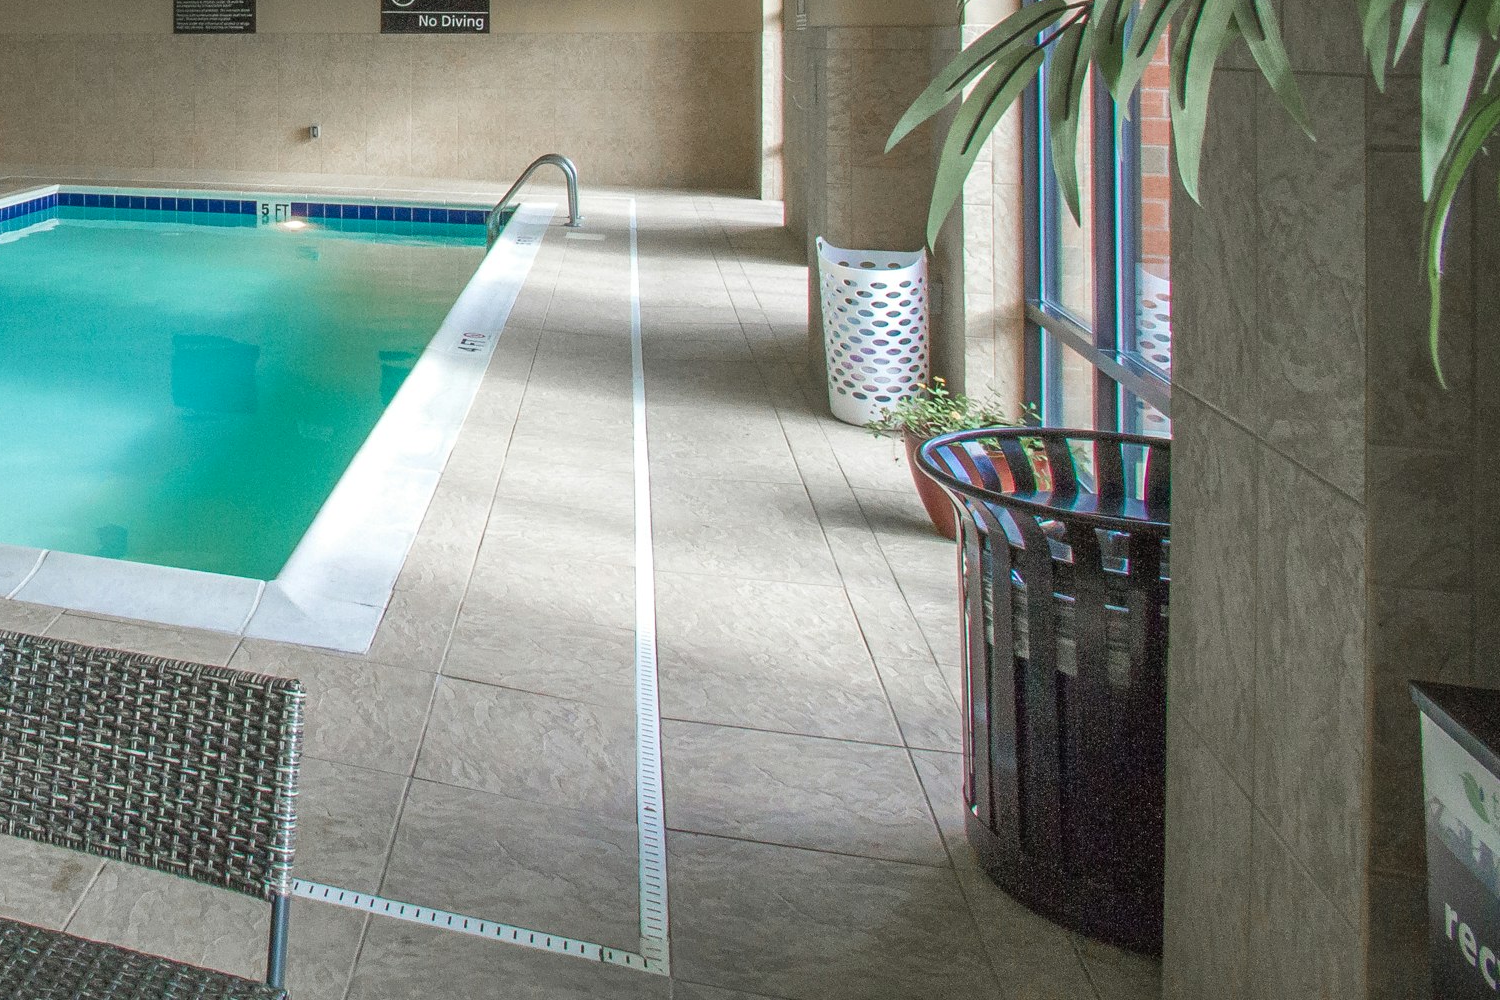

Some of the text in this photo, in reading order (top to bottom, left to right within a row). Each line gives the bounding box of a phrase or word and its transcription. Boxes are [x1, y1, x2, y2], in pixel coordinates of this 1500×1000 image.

[418, 14, 484, 30] No Diving
[261, 203, 289, 217] 5 FT
[1443, 902, 1500, 990] rec
